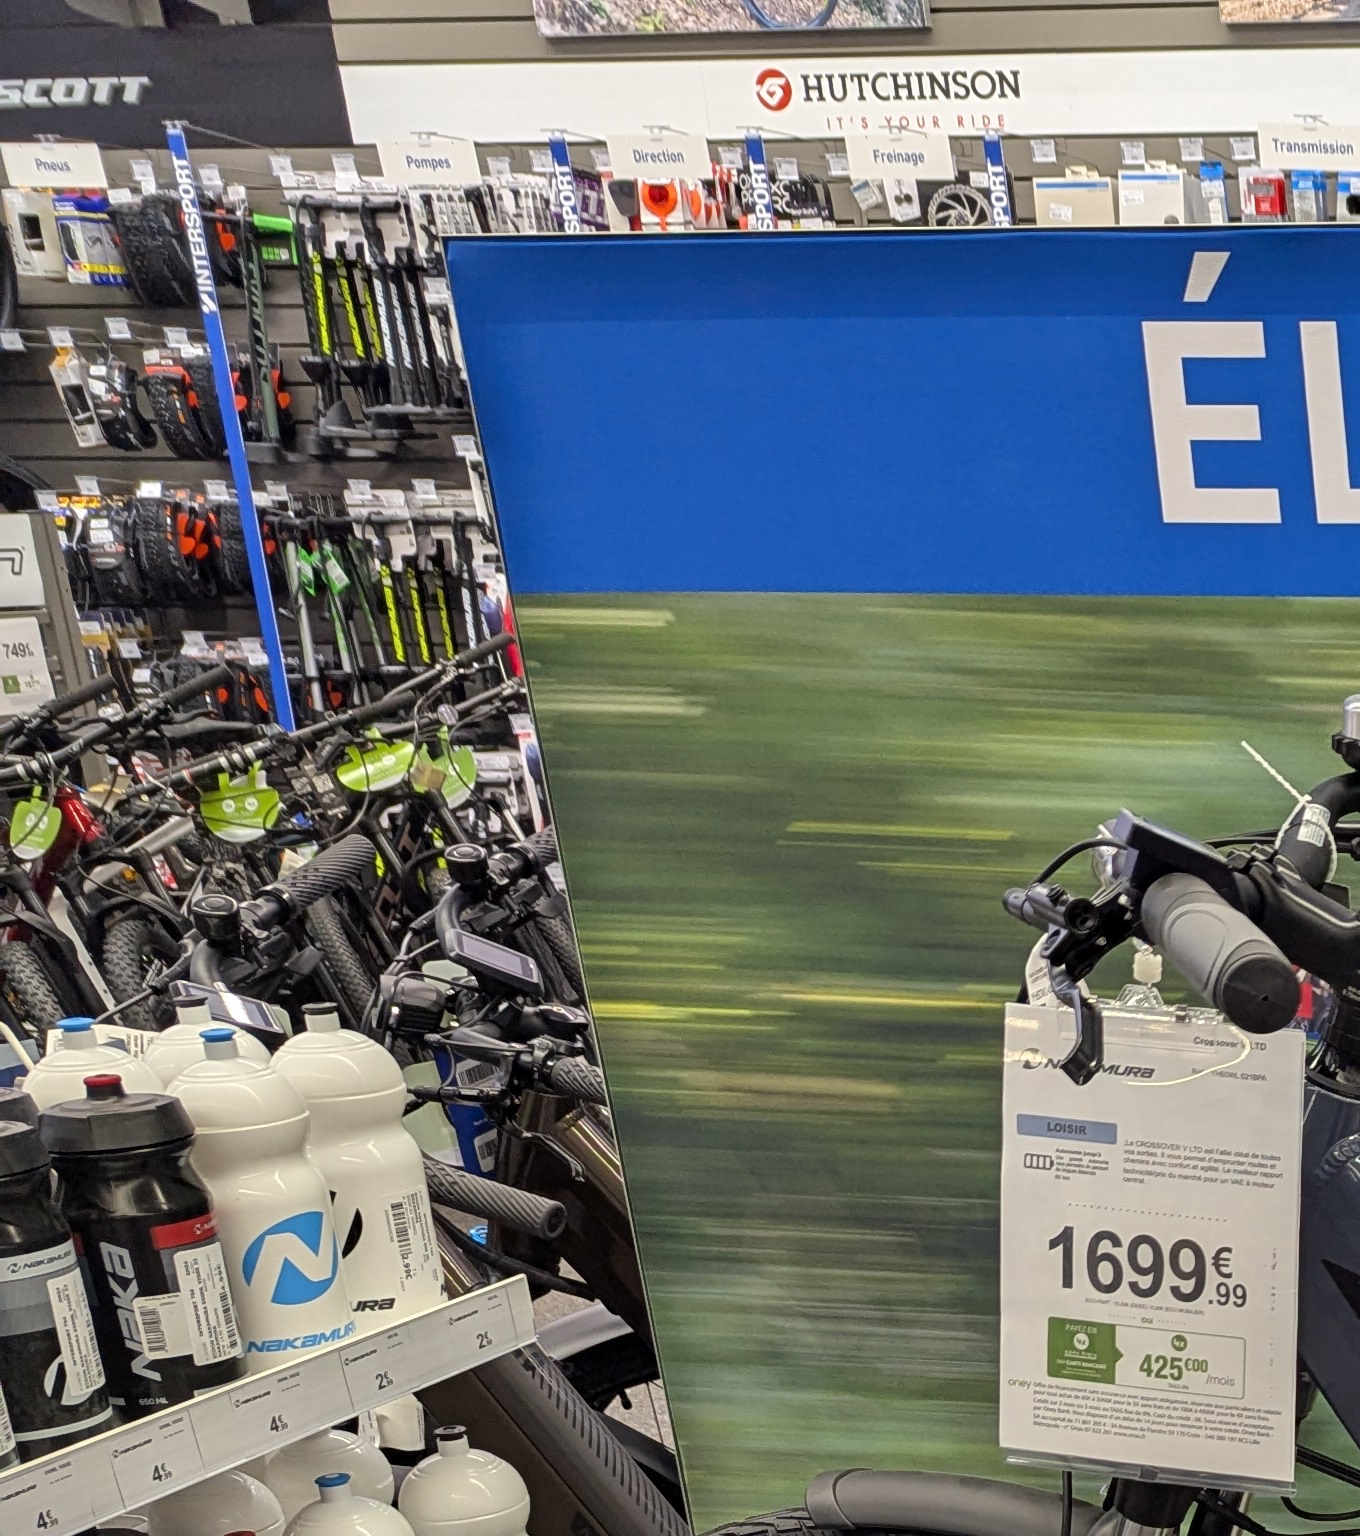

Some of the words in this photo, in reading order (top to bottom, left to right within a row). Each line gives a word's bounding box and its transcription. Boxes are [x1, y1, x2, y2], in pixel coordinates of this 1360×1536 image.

[0, 76, 150, 105] SCOTT
[802, 69, 1020, 102] HUTCHINSON
[827, 115, 869, 130] IT'S
[886, 114, 942, 130] YOUR
[957, 113, 1006, 128] RIDE
[632, 149, 685, 165] Direction
[1272, 139, 1354, 157] Transmission
[35, 157, 71, 173] Pneus
[406, 155, 451, 173] Pompes
[873, 149, 925, 166] Freinage
[173, 155, 210, 294] INTERSPORT
[1045, 1057, 1155, 1079] NMURA
[1047, 1121, 1087, 1136] LOISIR
[247, 1318, 356, 1354] NAKAMUR
